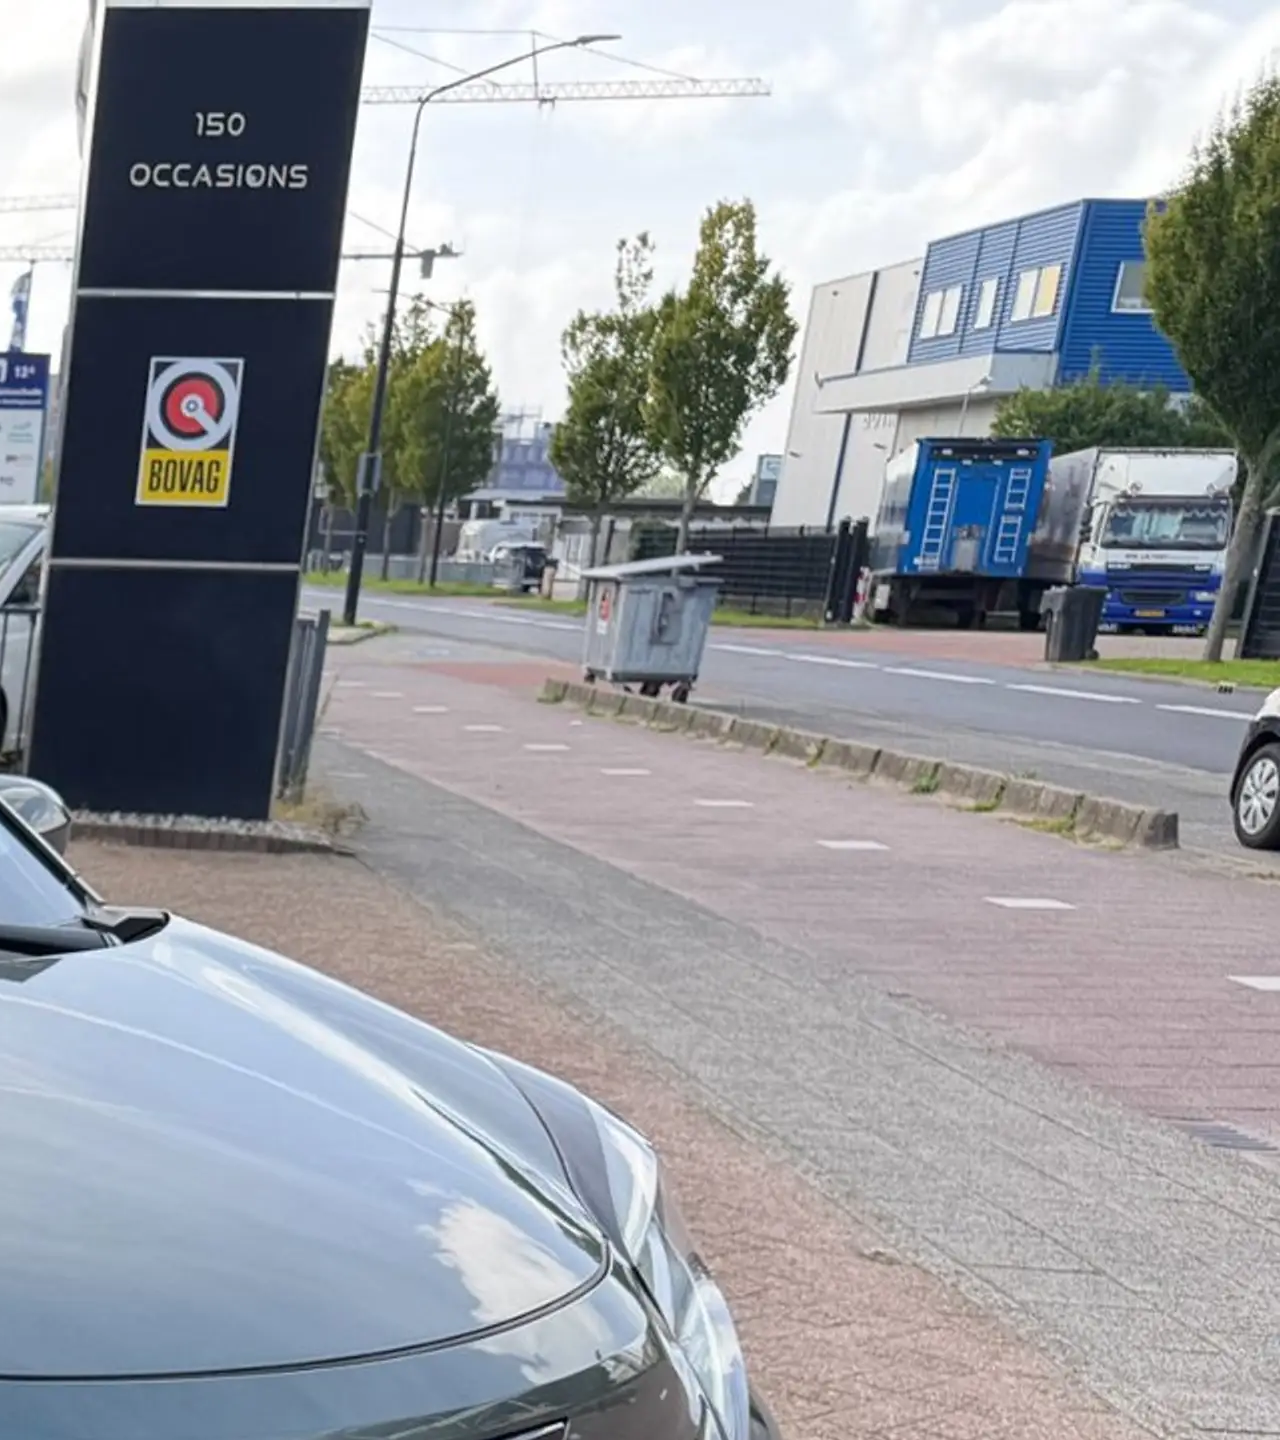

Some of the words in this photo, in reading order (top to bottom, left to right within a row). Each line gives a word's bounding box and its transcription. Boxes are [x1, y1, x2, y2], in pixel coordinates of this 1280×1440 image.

[195, 112, 246, 136] 150
[129, 163, 308, 188] OCCASIONS
[148, 458, 221, 494] BOVAG
